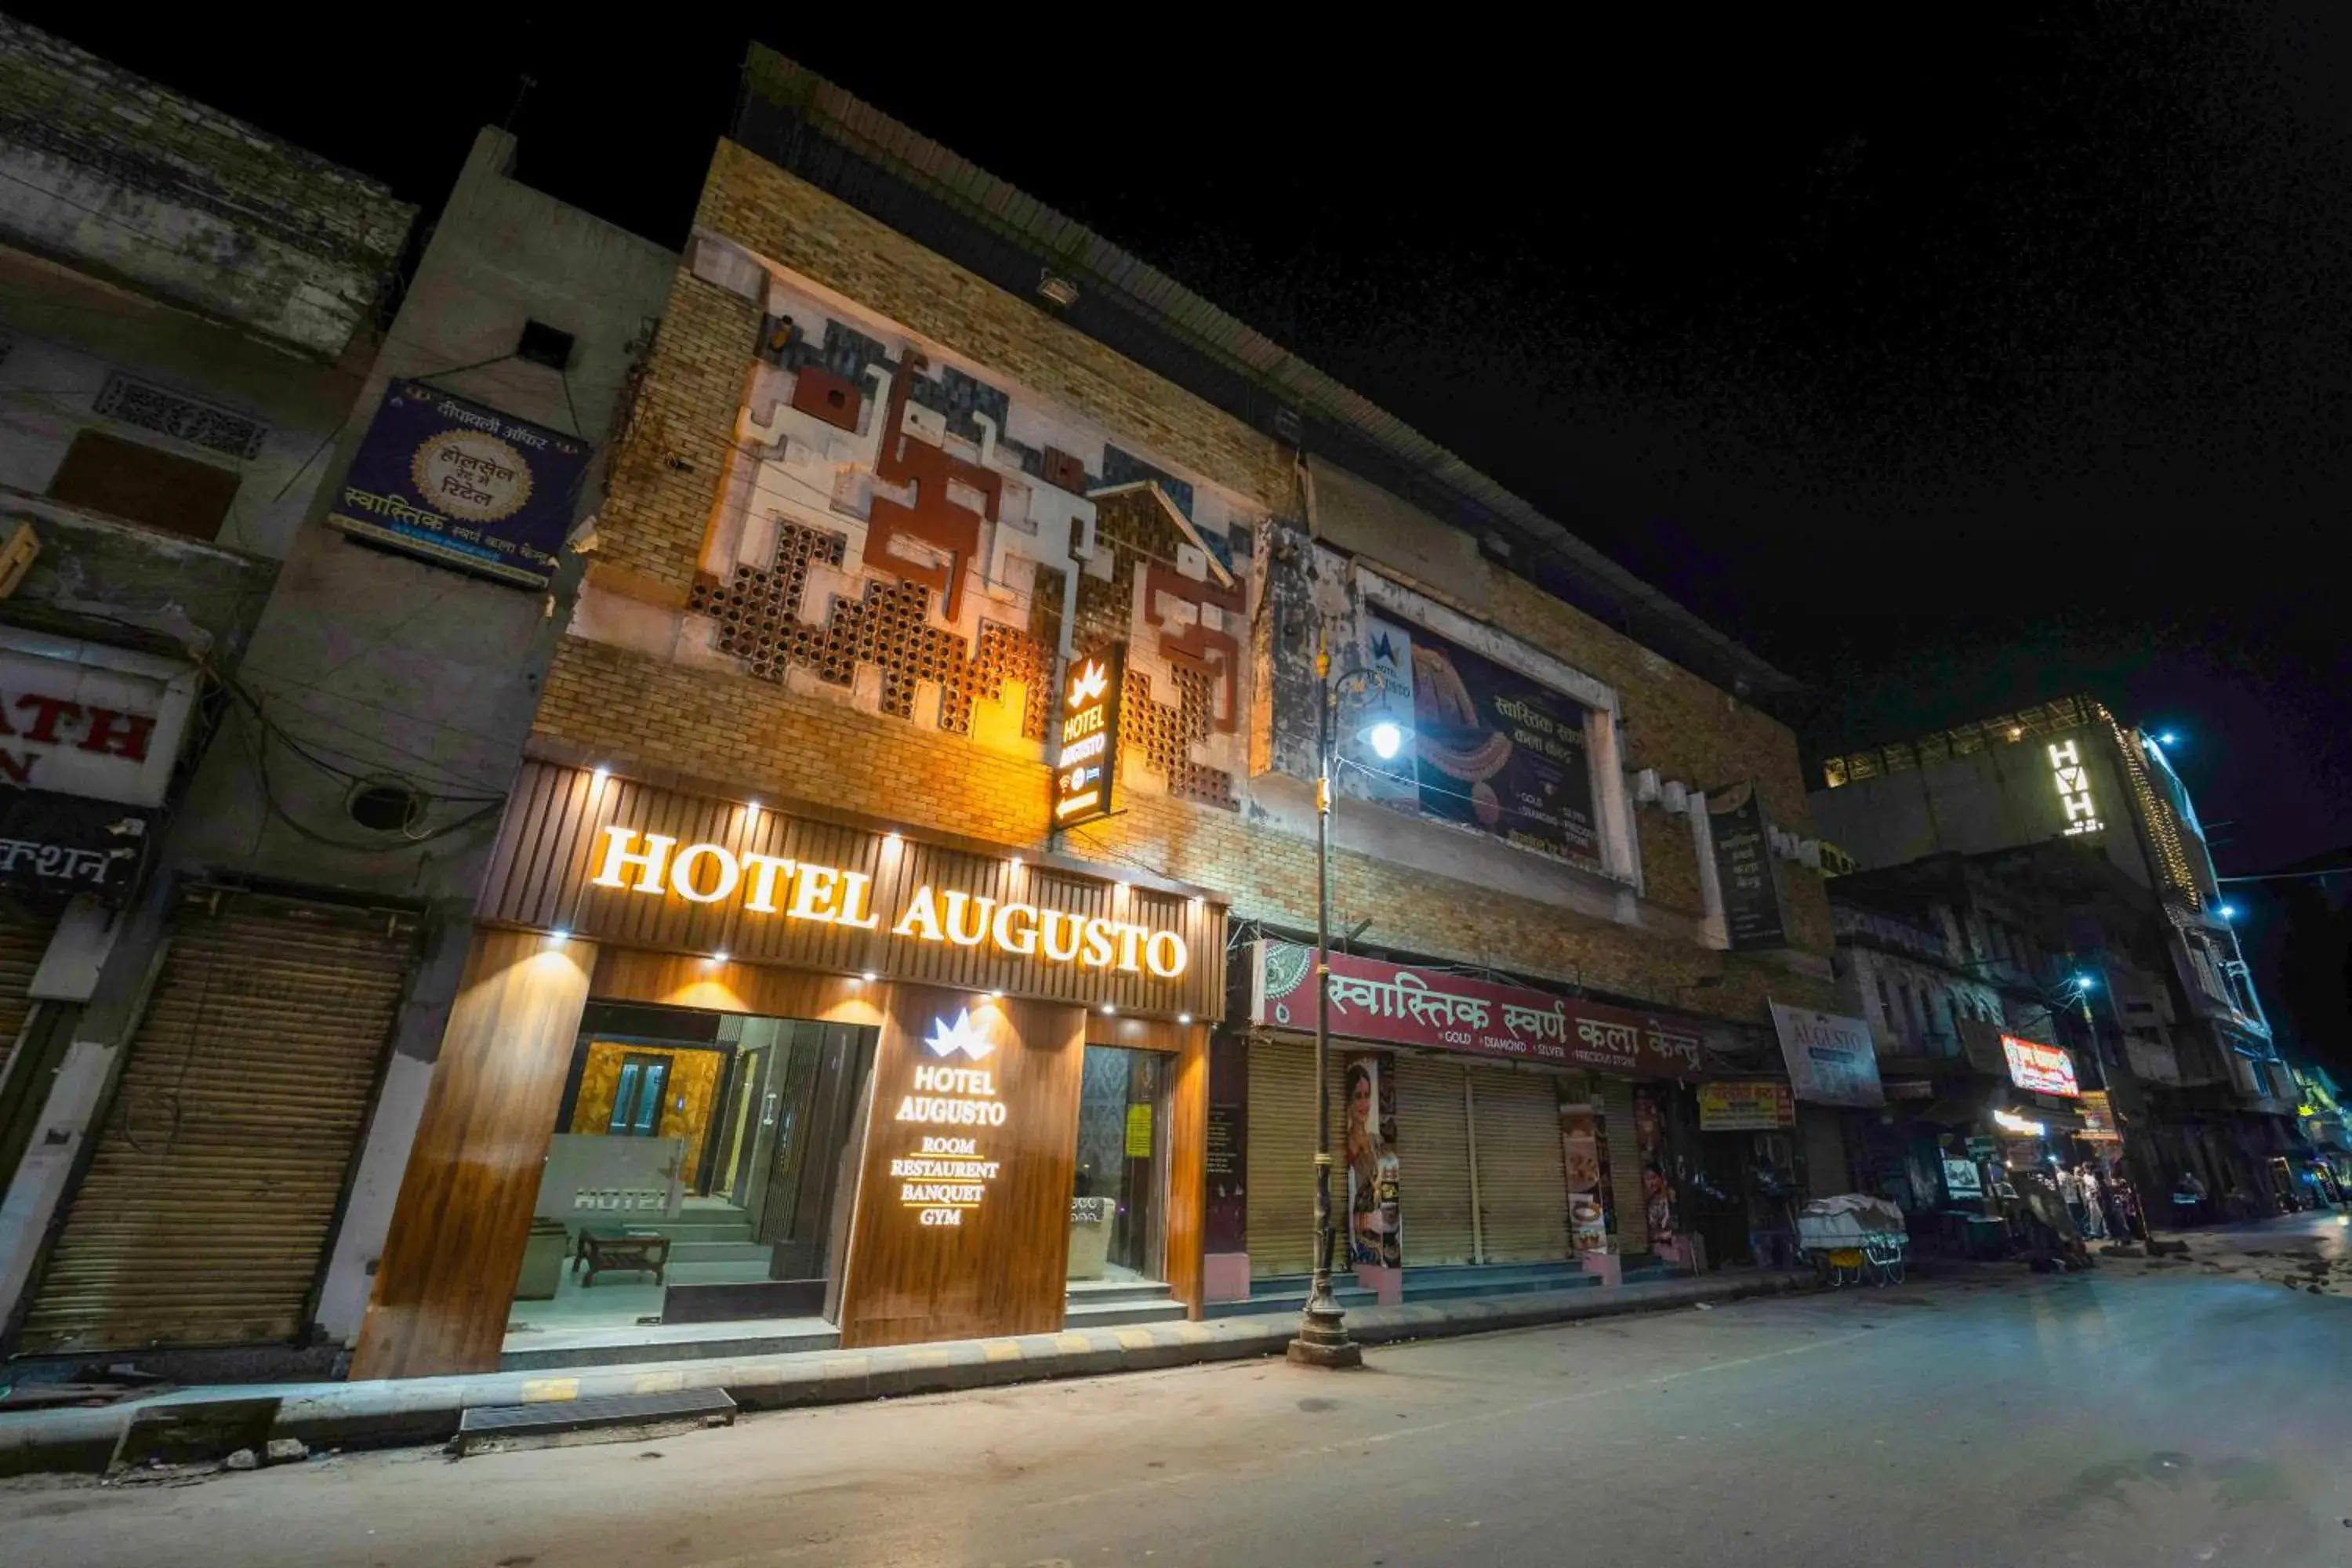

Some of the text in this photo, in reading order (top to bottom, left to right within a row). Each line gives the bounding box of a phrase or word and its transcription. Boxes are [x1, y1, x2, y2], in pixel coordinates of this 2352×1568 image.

[440, 445, 516, 482] होलसेल
[441, 476, 495, 506] रिटेल
[1063, 704, 1104, 742] HOTEL
[592, 826, 1187, 978] HOTEL AUGUSTO
[1327, 971, 1491, 1029] स्वास्तिक
[1501, 1000, 1567, 1044] स्वर्ण
[1575, 1018, 1639, 1054] कला
[1445, 1031, 1472, 1045] GOLD
[1483, 1036, 1527, 1053] DIAMOND
[1537, 1044, 1566, 1058] SILVER
[913, 1065, 996, 1095] HOTEL
[895, 1095, 1007, 1126] AUGUSTO
[922, 1136, 976, 1154] ROOM
[891, 1160, 1000, 1179] RESTAURENT
[574, 1189, 670, 1210] HOTEL
[901, 1184, 985, 1203] BANQUET
[920, 1209, 960, 1225] GYM
